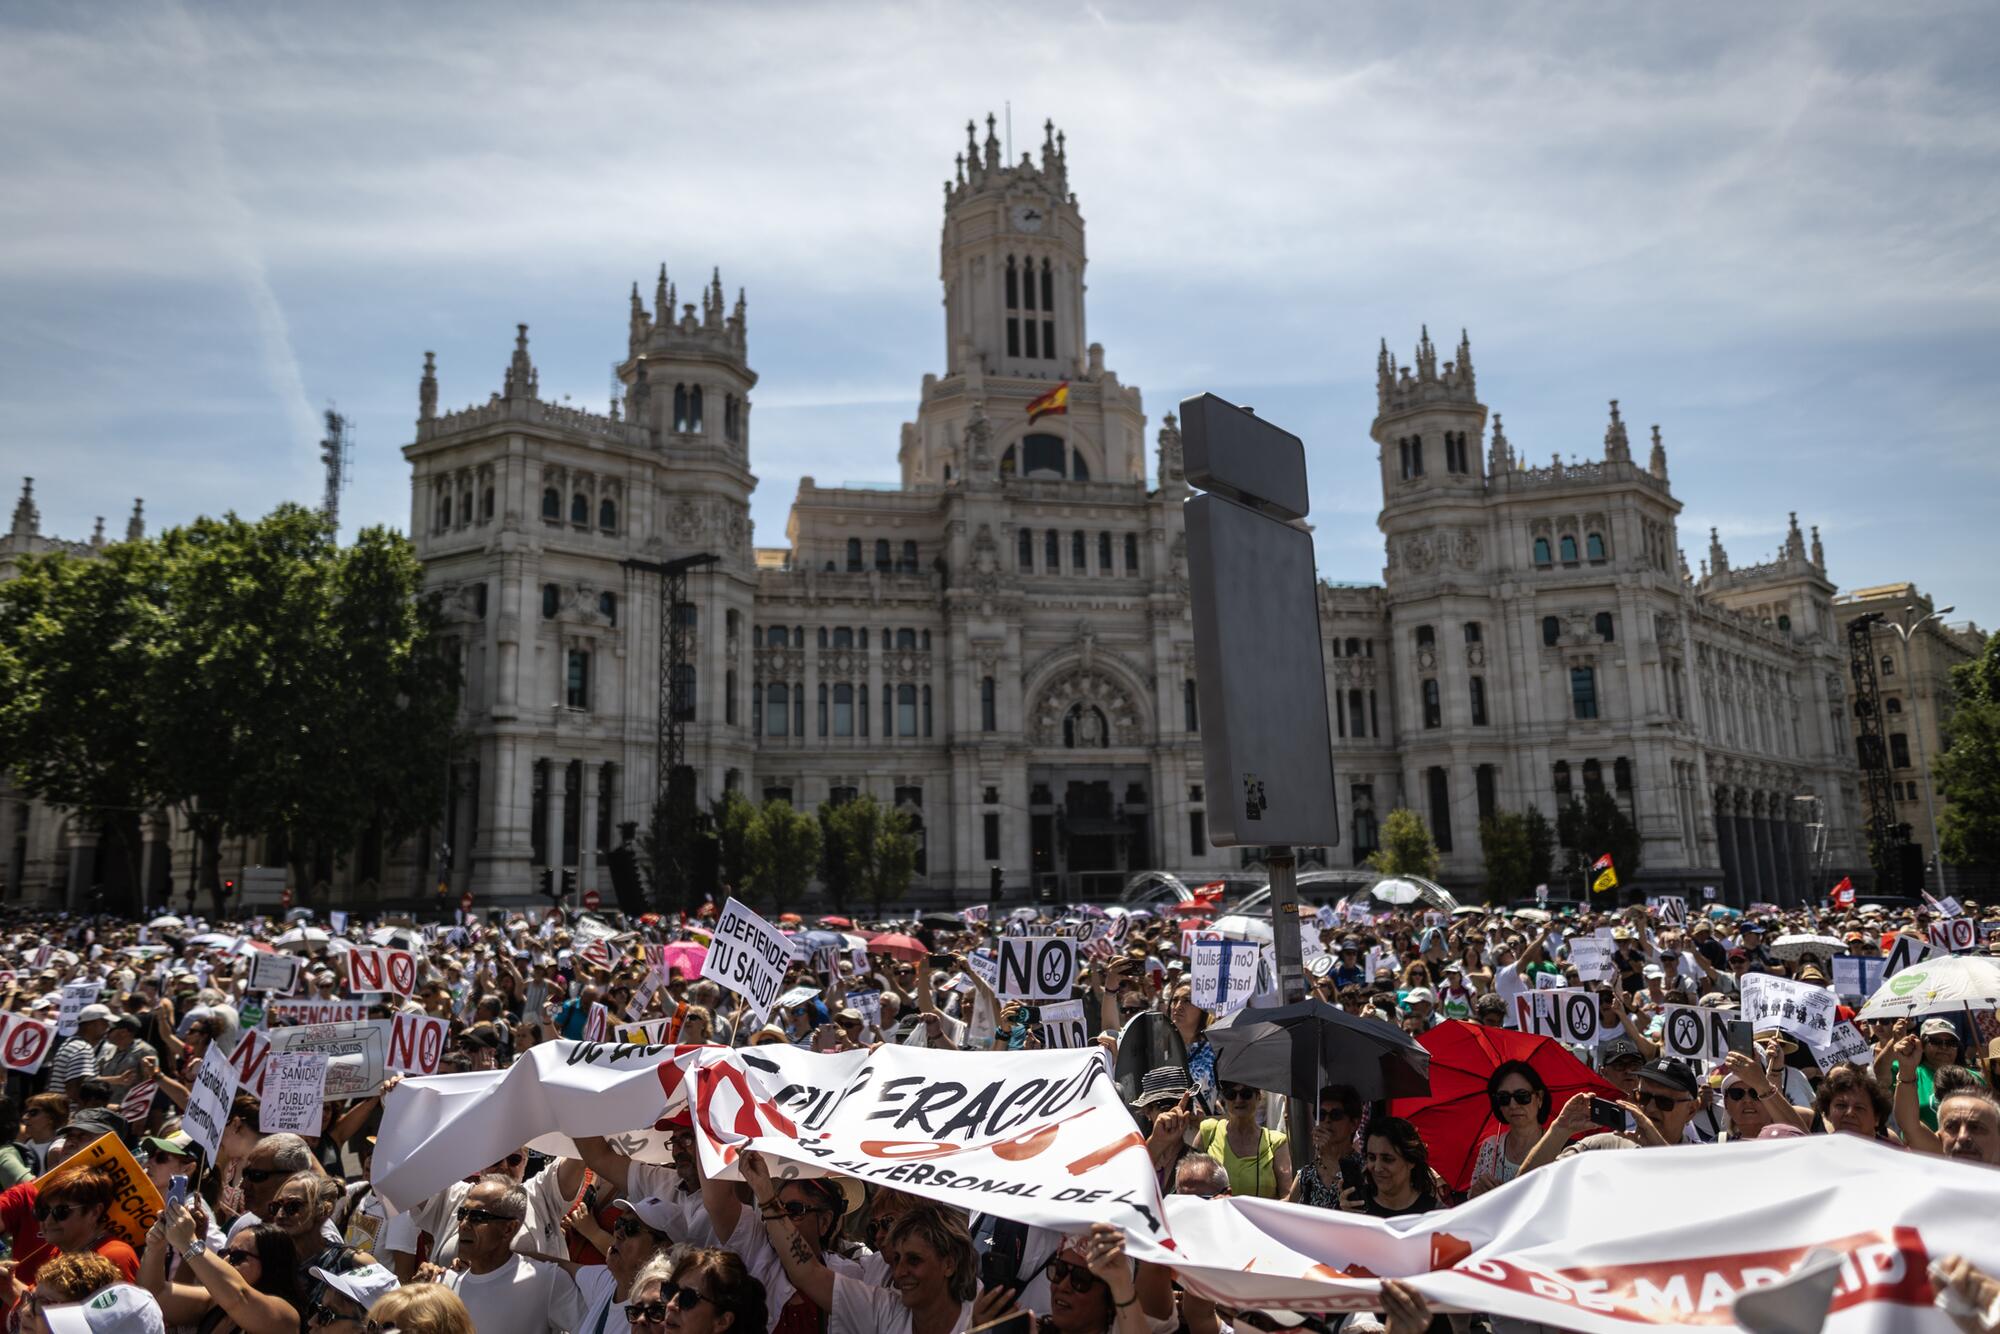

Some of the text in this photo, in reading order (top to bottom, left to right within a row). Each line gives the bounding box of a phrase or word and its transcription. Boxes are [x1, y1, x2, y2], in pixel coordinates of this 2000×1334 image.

[718, 912, 790, 975] ¡DEFIENDE
[1930, 919, 1973, 950] NO
[351, 949, 415, 996] NO
[710, 938, 778, 1013] TU SALUD!
[998, 940, 1072, 996] NO
[1533, 993, 1596, 1041] NO
[386, 1015, 442, 1074] NO
[1819, 1057, 1829, 1068] es
[867, 1161, 1043, 1198] PERSONAL
[1051, 1187, 1112, 1203] DE
